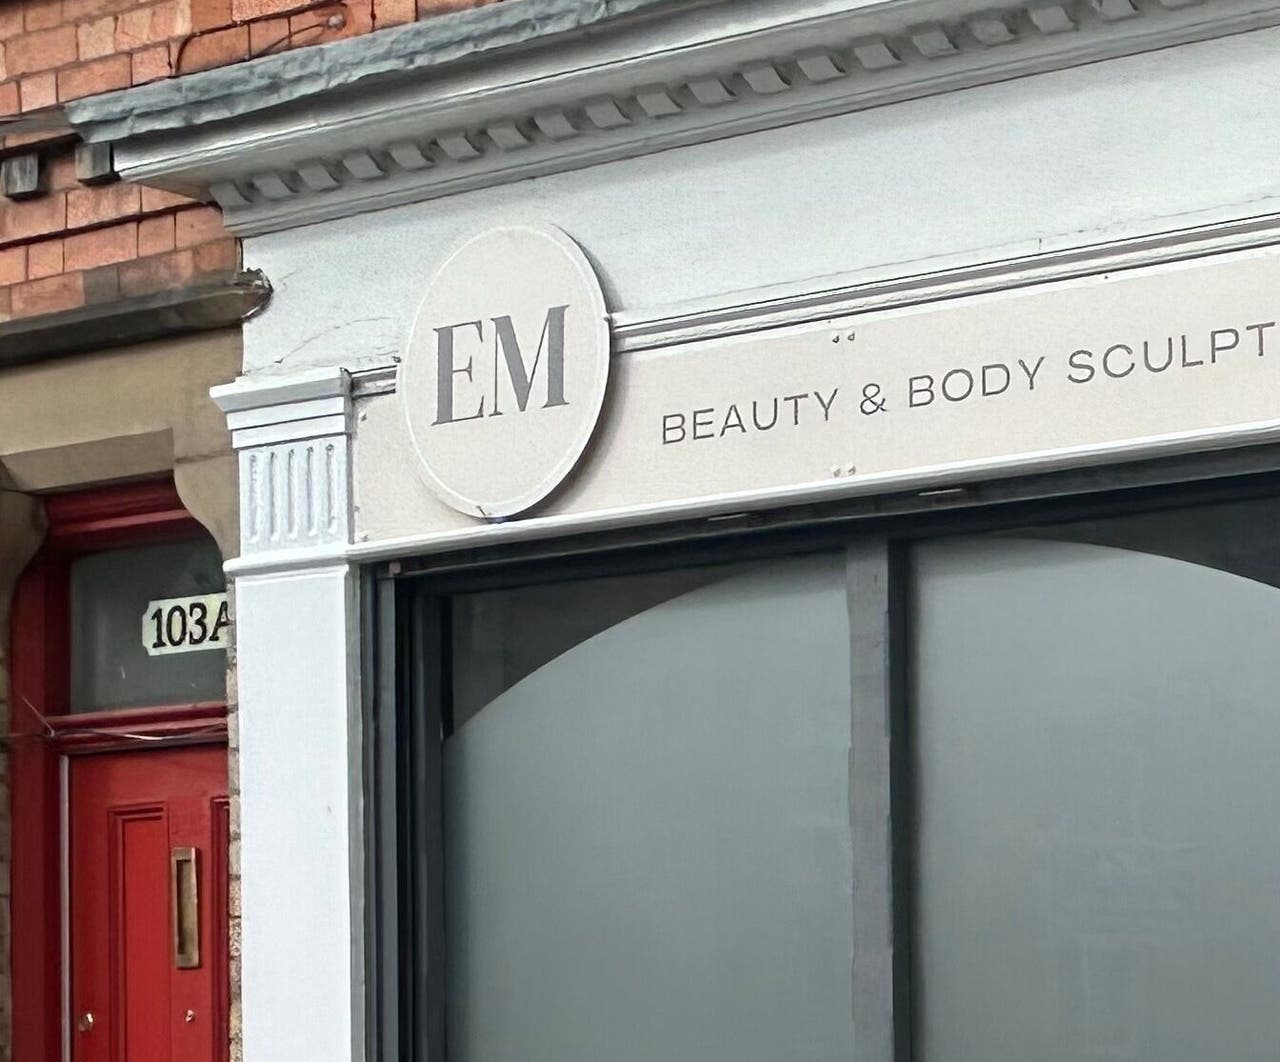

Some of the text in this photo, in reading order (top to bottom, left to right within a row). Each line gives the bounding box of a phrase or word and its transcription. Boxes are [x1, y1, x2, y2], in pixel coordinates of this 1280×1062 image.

[432, 304, 570, 426] EM
[662, 388, 838, 445] BEAUTY
[859, 383, 887, 416] &
[909, 356, 1045, 408] BODY
[151, 601, 233, 649] 103A
